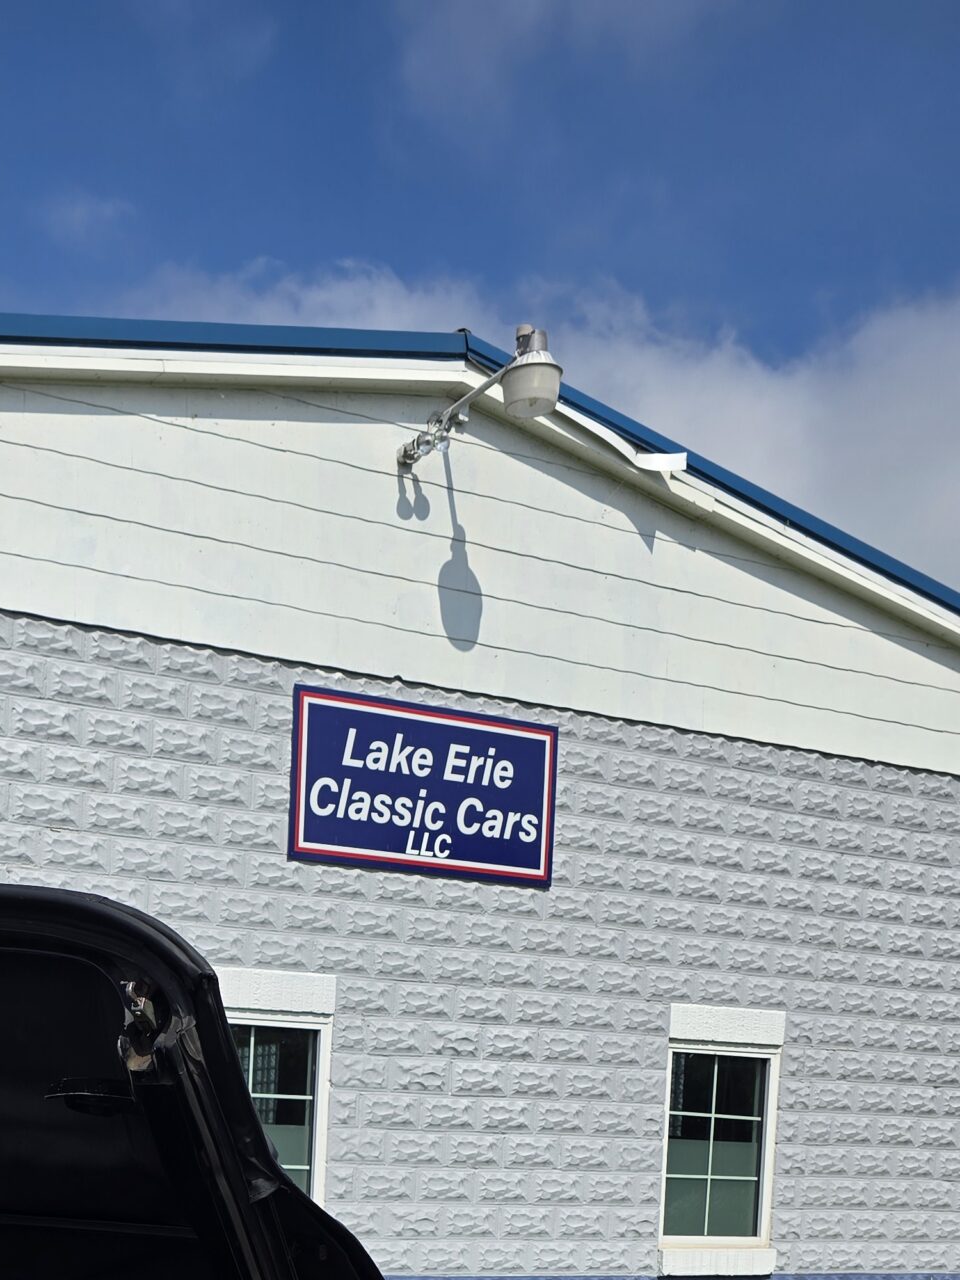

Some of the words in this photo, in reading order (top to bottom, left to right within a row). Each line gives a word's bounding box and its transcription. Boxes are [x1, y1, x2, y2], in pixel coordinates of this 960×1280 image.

[341, 727, 434, 778] Lake
[442, 743, 515, 790] Erie
[309, 776, 447, 832] Classic
[456, 796, 539, 844] Cars
[404, 830, 453, 859] LLC
